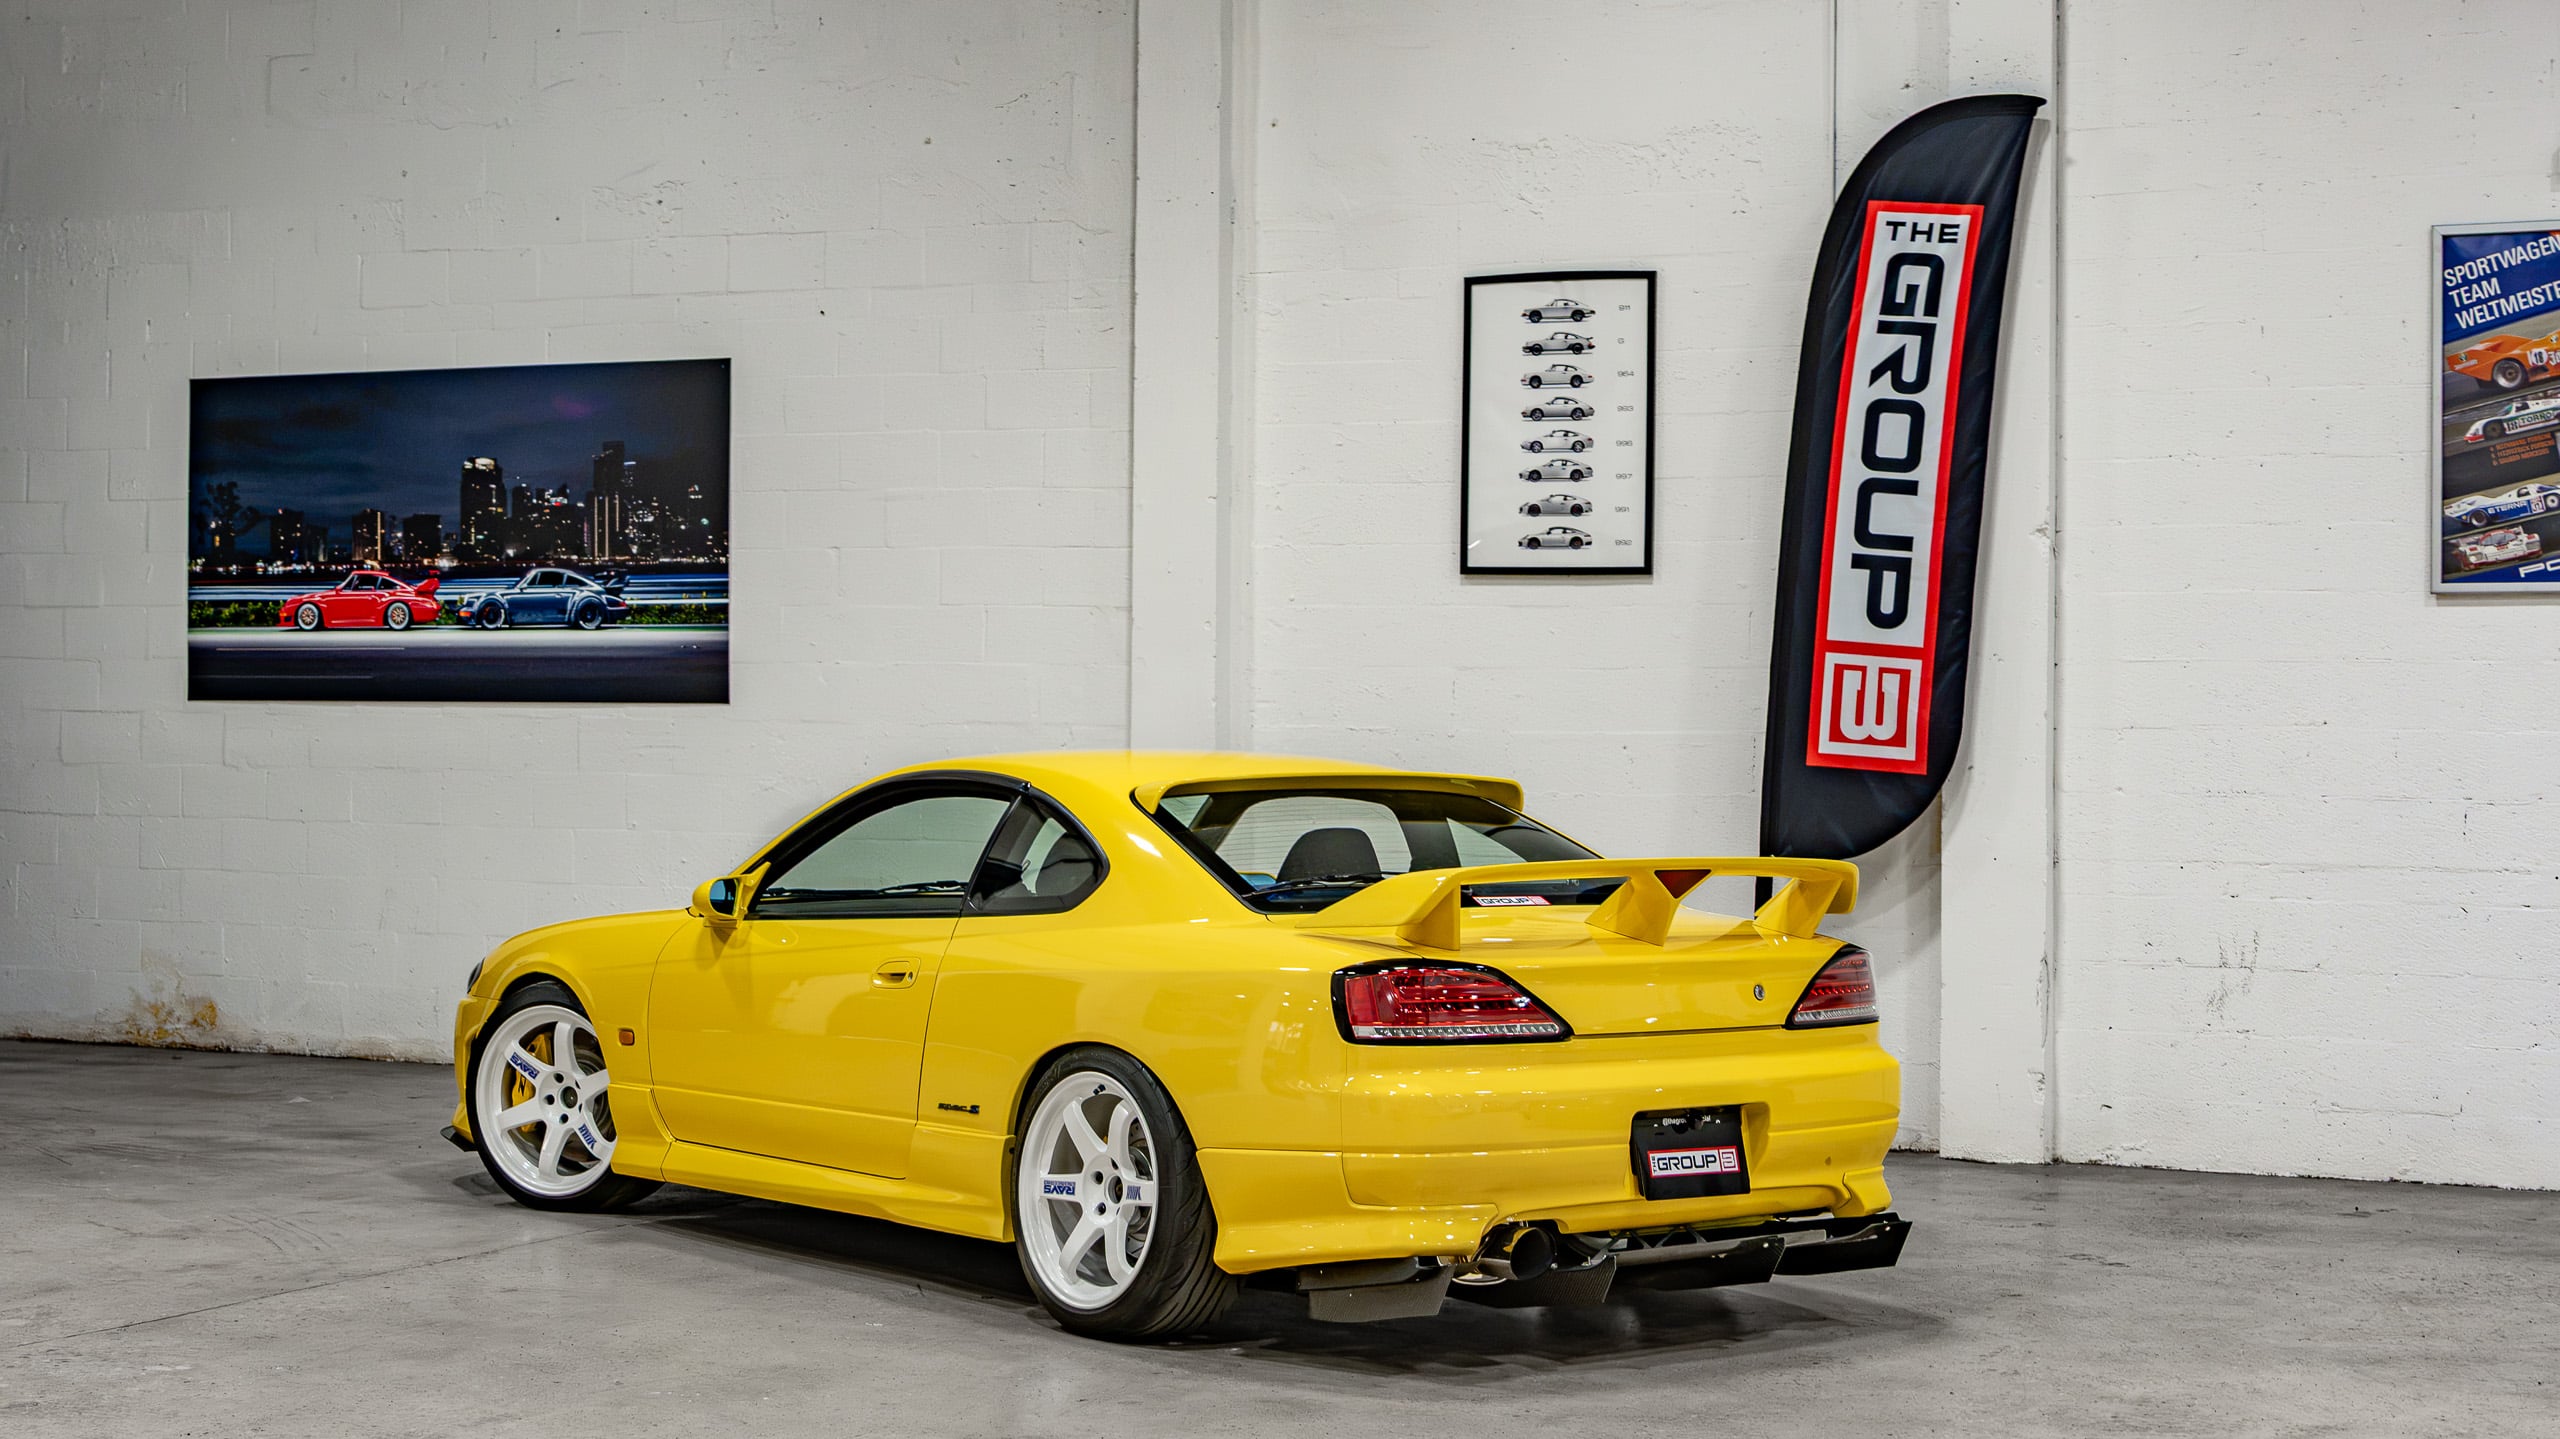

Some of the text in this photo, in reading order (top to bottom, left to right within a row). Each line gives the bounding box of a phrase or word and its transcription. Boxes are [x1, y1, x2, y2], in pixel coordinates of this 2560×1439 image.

[1885, 220, 1961, 244] THE
[2444, 235, 2560, 287] SPORTWAGEN
[2449, 277, 2501, 308] TEAM
[1851, 252, 1945, 630] GROUP
[1657, 1154, 1717, 1171] GROUP
[1044, 1184, 1076, 1196] RAYS
